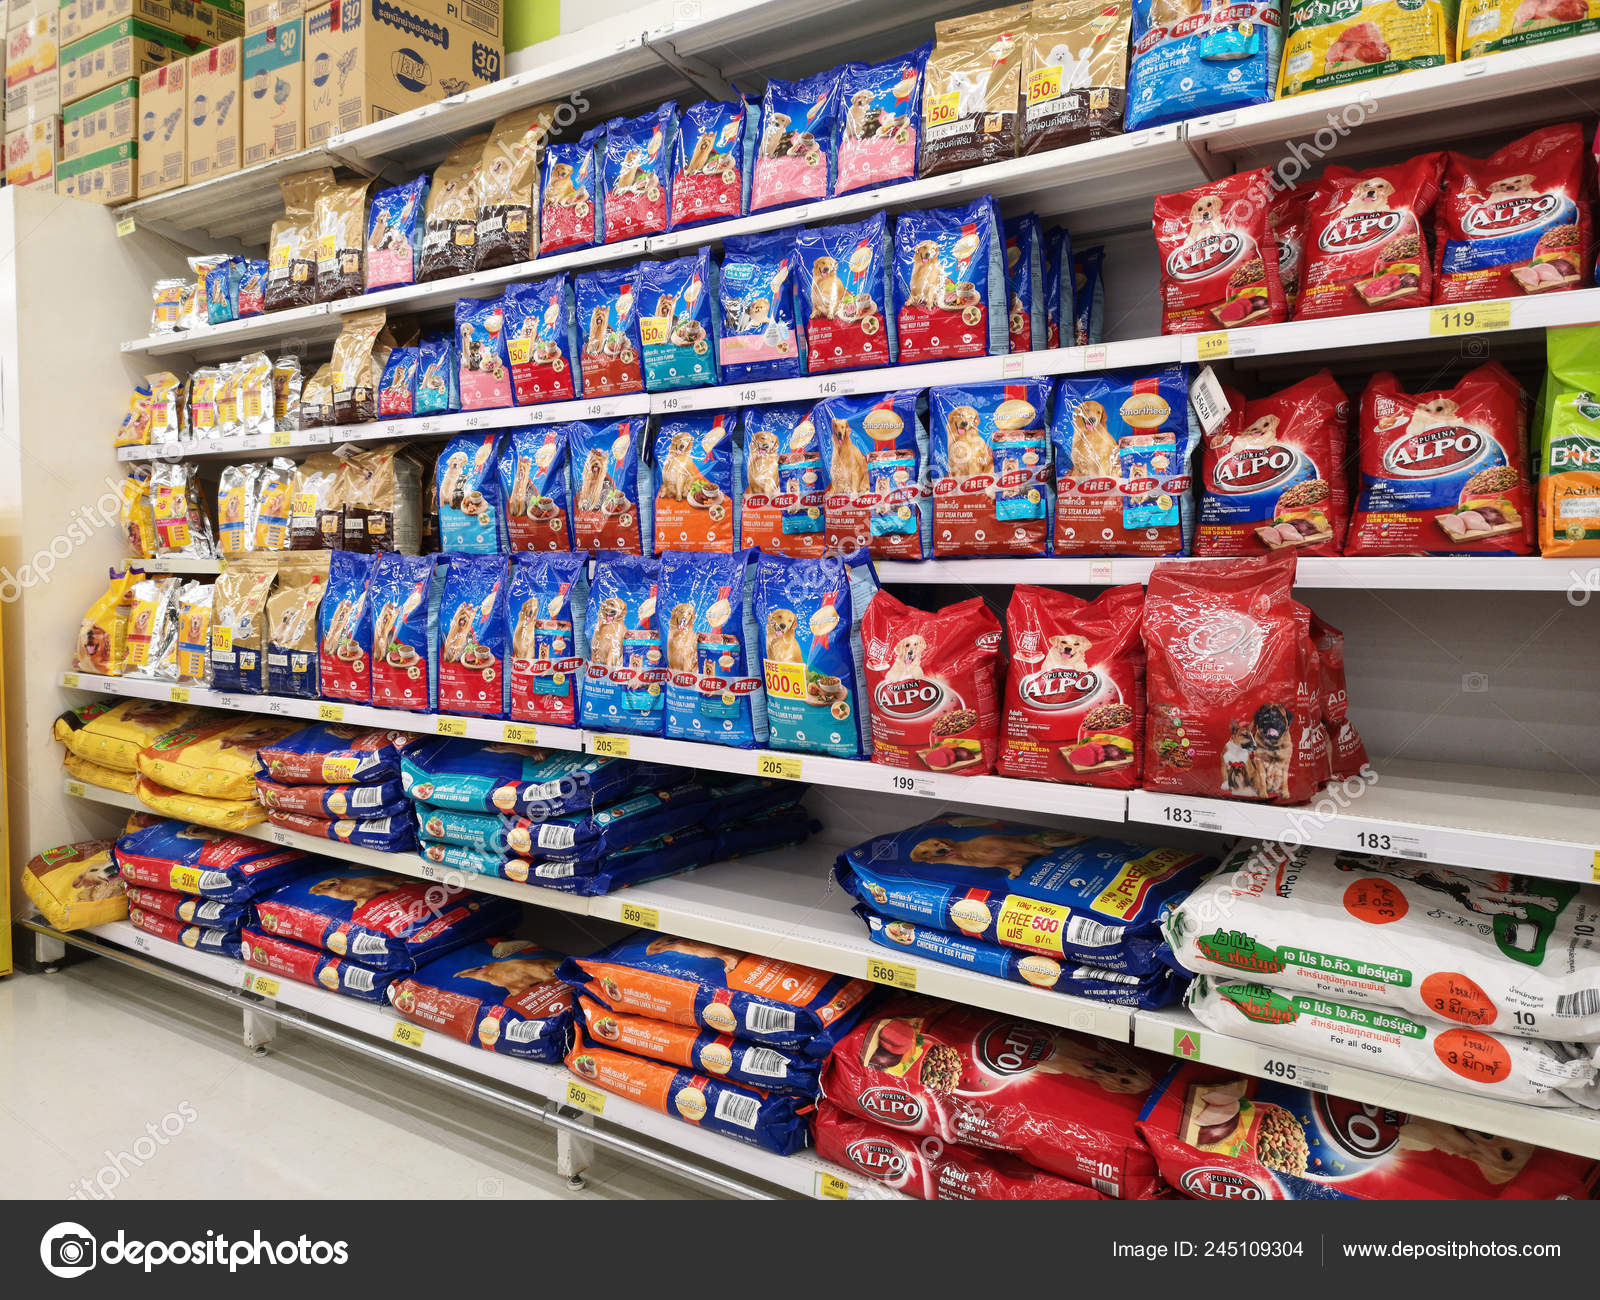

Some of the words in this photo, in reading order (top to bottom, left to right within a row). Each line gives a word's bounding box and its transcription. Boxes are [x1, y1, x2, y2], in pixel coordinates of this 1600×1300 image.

[344, 2, 360, 21] 30
[1140, 32, 1162, 49] FREE
[1177, 14, 1206, 33] FREE
[1220, 6, 1252, 20] FREE
[280, 31, 296, 50] 30
[1502, 37, 1519, 45] Beef
[1525, 30, 1552, 40] Chicken
[1552, 26, 1570, 34] Liver
[474, 49, 498, 73] 30
[1427, 58, 1434, 66] 3
[1316, 74, 1330, 84] Beef
[1336, 70, 1359, 81] Chicken
[1359, 67, 1375, 76] Liver
[1028, 81, 1050, 100] 150
[928, 104, 949, 123] 150
[1495, 197, 1533, 210] PURINA
[1471, 195, 1554, 227] ALPO
[1327, 212, 1399, 244] ALPO
[1172, 236, 1238, 273] ALPO
[1441, 311, 1475, 328] 119
[642, 327, 658, 341] 150
[1206, 339, 1222, 348] 119
[509, 349, 522, 361] 150
[818, 382, 837, 394] 146
[740, 390, 756, 401] 149
[588, 405, 600, 415] 149
[663, 399, 678, 409] 149
[1119, 406, 1171, 416] SmartHeart
[466, 418, 478, 426] 149
[530, 411, 543, 421] 149
[862, 421, 905, 430] SmartHeart
[1418, 430, 1456, 444] PURINA
[1391, 434, 1479, 468] ALPO
[1218, 451, 1291, 481] ALPO
[965, 478, 989, 489] FREE
[1001, 472, 1028, 485] FREE
[1084, 480, 1111, 492] FREE
[1125, 479, 1153, 492] FREE
[1168, 480, 1190, 490] FREE
[1563, 485, 1600, 497] Adult
[749, 498, 765, 506] FREE
[774, 496, 794, 505] FREE
[828, 498, 846, 507] FREE
[855, 497, 878, 506] FREE
[889, 490, 913, 500] FREE
[957, 511, 973, 519] FLAVOR
[1082, 508, 1101, 516] FLAVOR
[533, 662, 548, 672] FREE
[557, 660, 581, 671] FREE
[765, 662, 779, 672] FREE
[589, 667, 604, 677] FREE
[612, 671, 632, 680] FREE
[643, 671, 667, 682] FREE
[676, 674, 694, 685] FREE
[701, 679, 723, 691] FREE
[734, 680, 761, 691] FREE
[766, 672, 791, 694] 300
[793, 683, 804, 696] G.
[893, 681, 919, 690] PURINA
[1025, 674, 1095, 699] ALPO
[880, 686, 937, 706] ALPO
[321, 708, 332, 718] 245
[439, 723, 452, 732] 245
[507, 729, 522, 740] 205
[596, 740, 612, 752] 205
[763, 761, 782, 774] 205
[892, 775, 914, 790] 199
[1162, 806, 1193, 824] 183
[274, 832, 285, 842] 769
[1356, 832, 1392, 851] 183
[421, 866, 434, 877] 769
[623, 908, 641, 922] 569
[917, 906, 932, 914] FLAVOR
[950, 909, 992, 924] SmartHeart
[1037, 905, 1051, 914] 500
[1001, 910, 1031, 928] FREE
[1031, 916, 1059, 934] 500
[1006, 927, 1023, 940] ฟรี
[1574, 925, 1596, 938] 10
[917, 939, 938, 952] CHICKEN
[944, 946, 954, 957] EGG
[954, 949, 975, 962] FLAVOR
[872, 966, 895, 981] 569
[1017, 960, 1062, 977] SmartHeart
[1284, 951, 1297, 962] เอ
[1299, 952, 1317, 967] โปร
[1321, 956, 1353, 973] ไอ.คิว.
[1357, 964, 1404, 984] ฟอร์มูล่า
[256, 981, 268, 991] 569
[1317, 983, 1332, 991] For
[525, 998, 541, 1011] BEEF
[540, 991, 553, 1005] STEAK
[623, 997, 639, 1006] SMOKED
[640, 999, 651, 1008] LIVER
[651, 1002, 667, 1013] FLAVOR
[1434, 998, 1445, 1011] 3
[1505, 996, 1518, 1004] Net
[1520, 1000, 1544, 1009] Weight
[424, 1011, 434, 1021] STEAK
[433, 1015, 446, 1025] FLAVOR
[1300, 1000, 1311, 1011] เอ
[1314, 1000, 1332, 1016] โปร
[1336, 1005, 1369, 1023] ไอ.คิว.
[1373, 1013, 1418, 1035] ฟอร์มูล่า
[1513, 1010, 1536, 1026] 10
[396, 1028, 410, 1041] 569
[1310, 1018, 1401, 1047] สำหรับสุนัขทุกสายพันธุ์
[621, 1034, 635, 1044] SMOKED
[636, 1037, 648, 1047] LIVER
[648, 1040, 664, 1052] FLAVOR
[1331, 1035, 1345, 1044] For
[1347, 1038, 1358, 1047] all
[1361, 1042, 1382, 1054] dogs
[1448, 1051, 1458, 1065] 3
[1264, 1059, 1297, 1080] 495
[614, 1079, 626, 1090] LIVER
[626, 1083, 642, 1095] FLAVOR
[570, 1090, 587, 1104] 569
[880, 1092, 905, 1101] PURINA
[863, 1096, 919, 1118] ALPO
[960, 1111, 990, 1128] Adult
[869, 1145, 893, 1154] PURINA
[850, 1148, 902, 1171] ALPO
[941, 1166, 970, 1182] Adult
[1097, 1163, 1112, 1178] 10
[830, 1179, 845, 1190] 469
[1211, 1174, 1246, 1186] PURINA
[1187, 1176, 1264, 1200] ALPO
